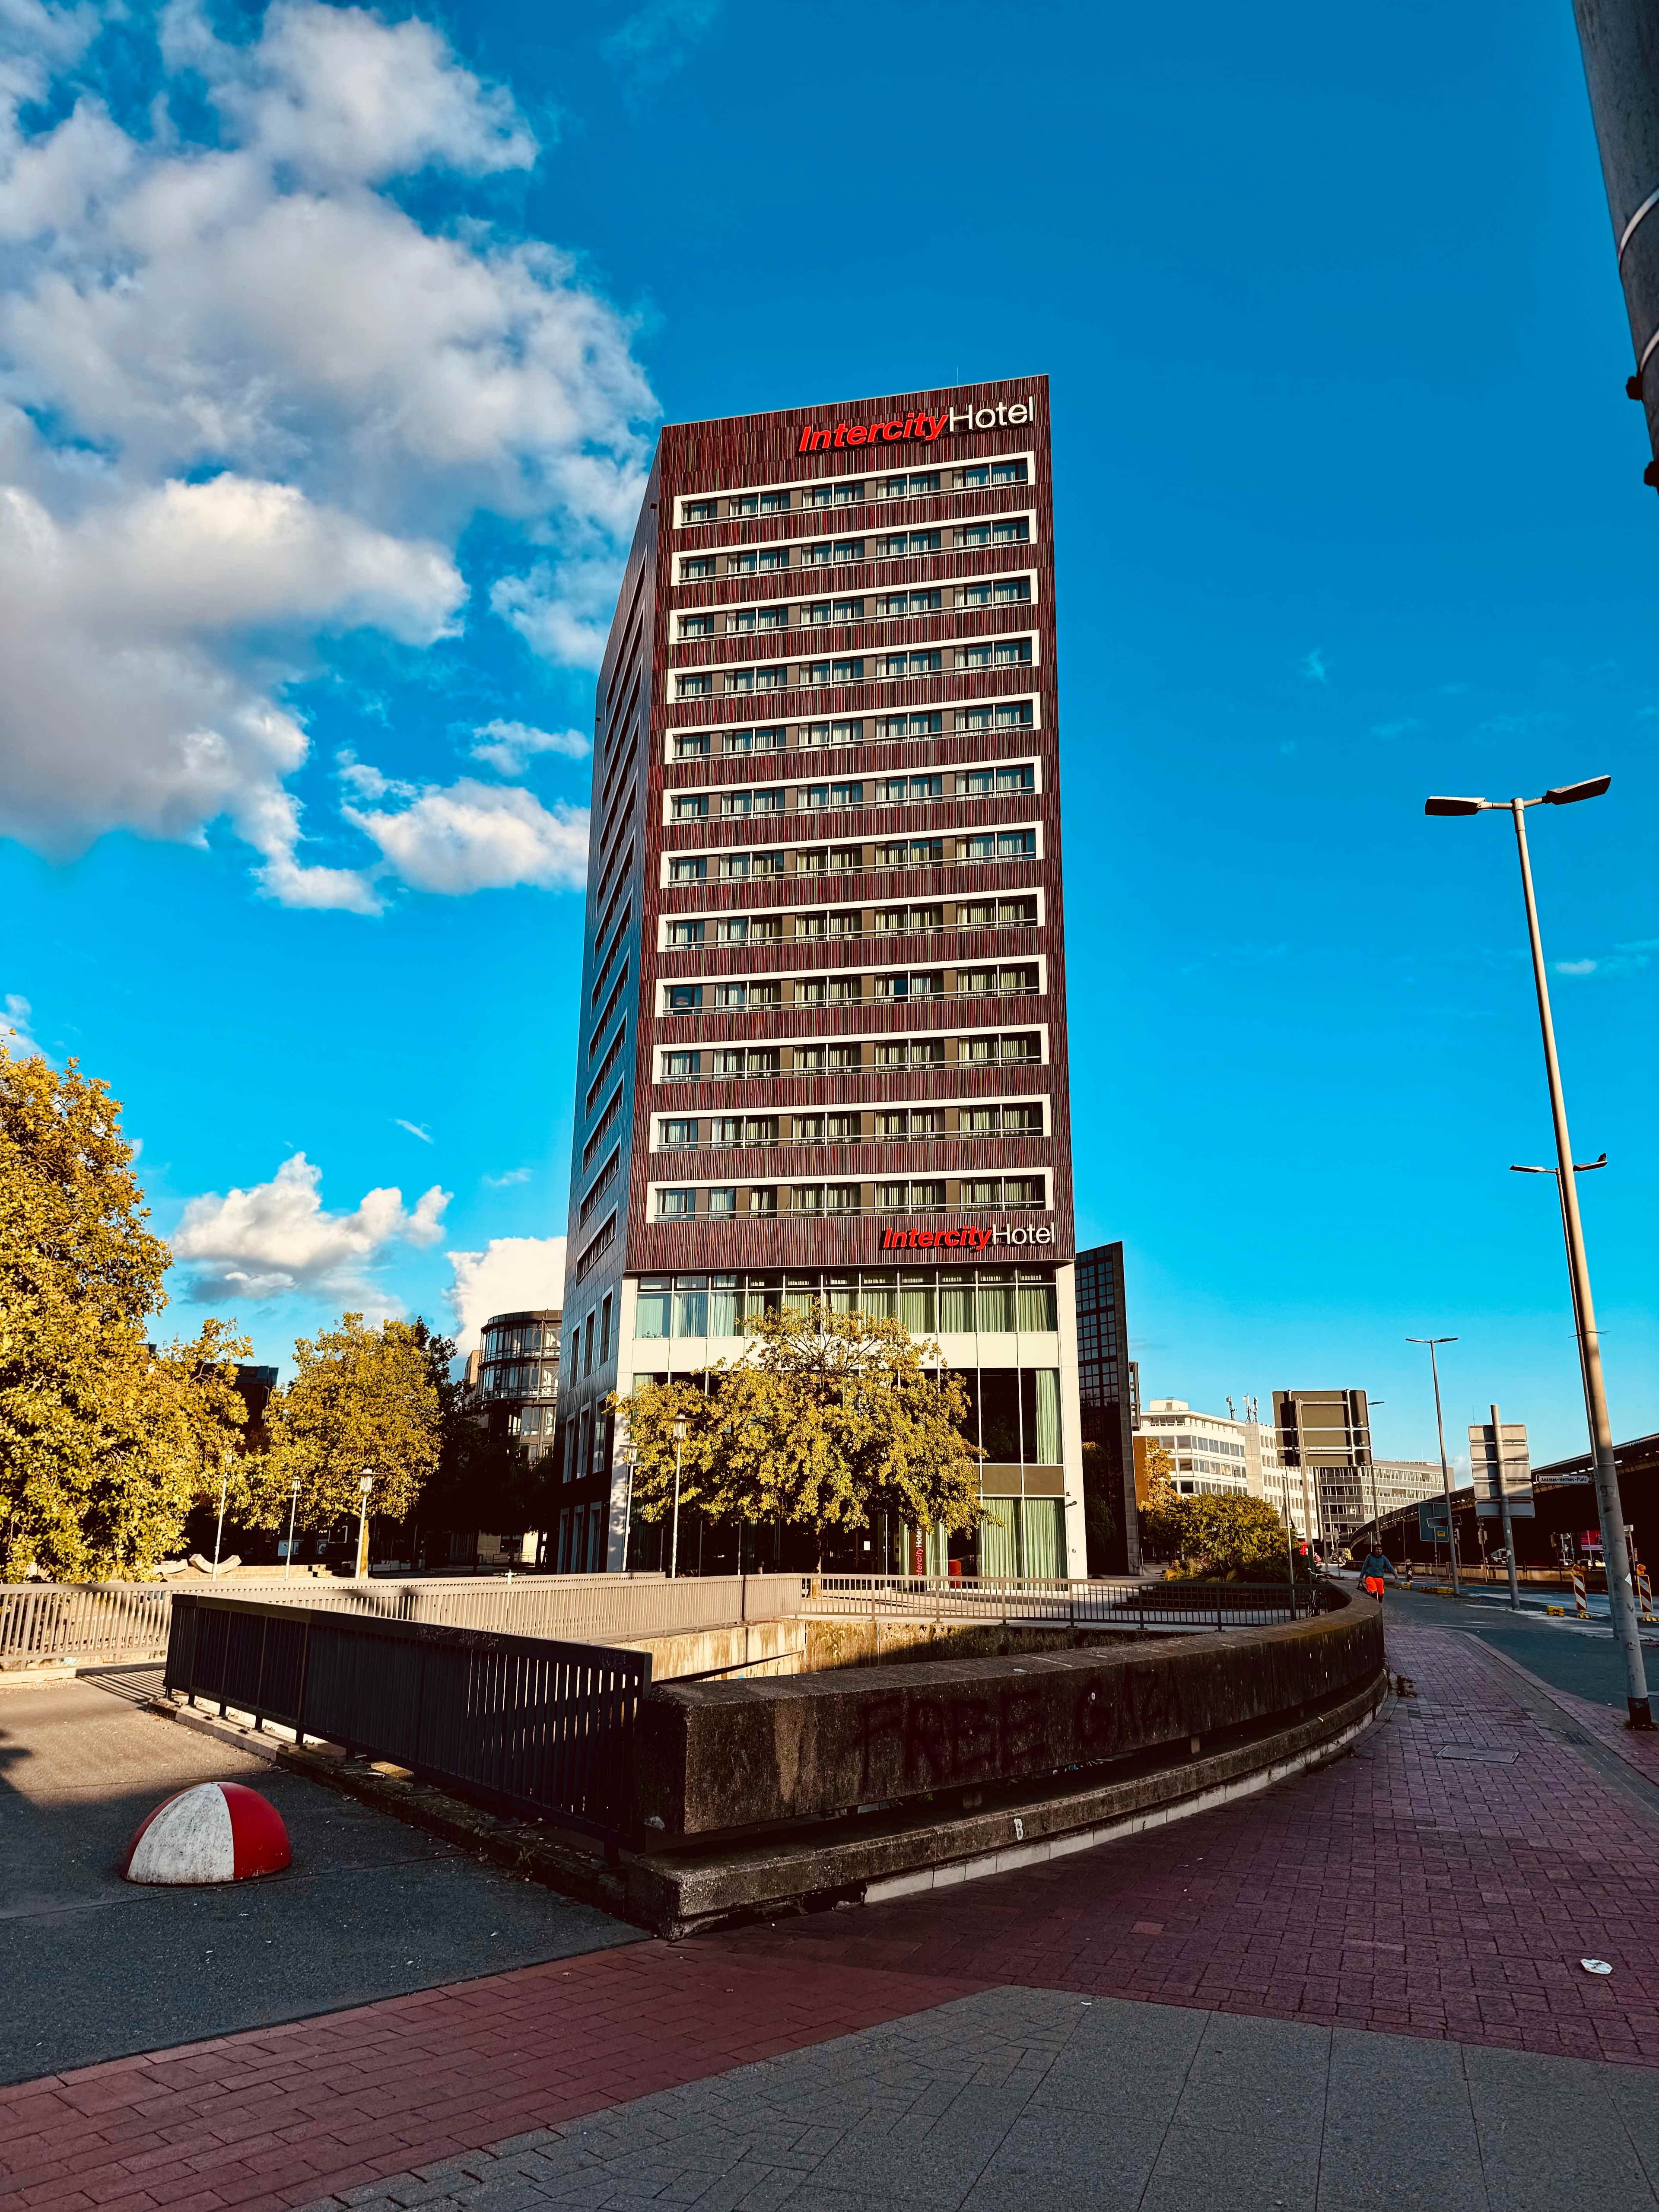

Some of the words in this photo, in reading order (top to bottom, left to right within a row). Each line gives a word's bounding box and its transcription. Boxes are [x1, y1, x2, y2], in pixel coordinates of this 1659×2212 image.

[798, 396, 1033, 451] IntercityHotel
[883, 1222, 1055, 1250] IntercityHotel
[852, 1688, 1046, 1793] FREE
